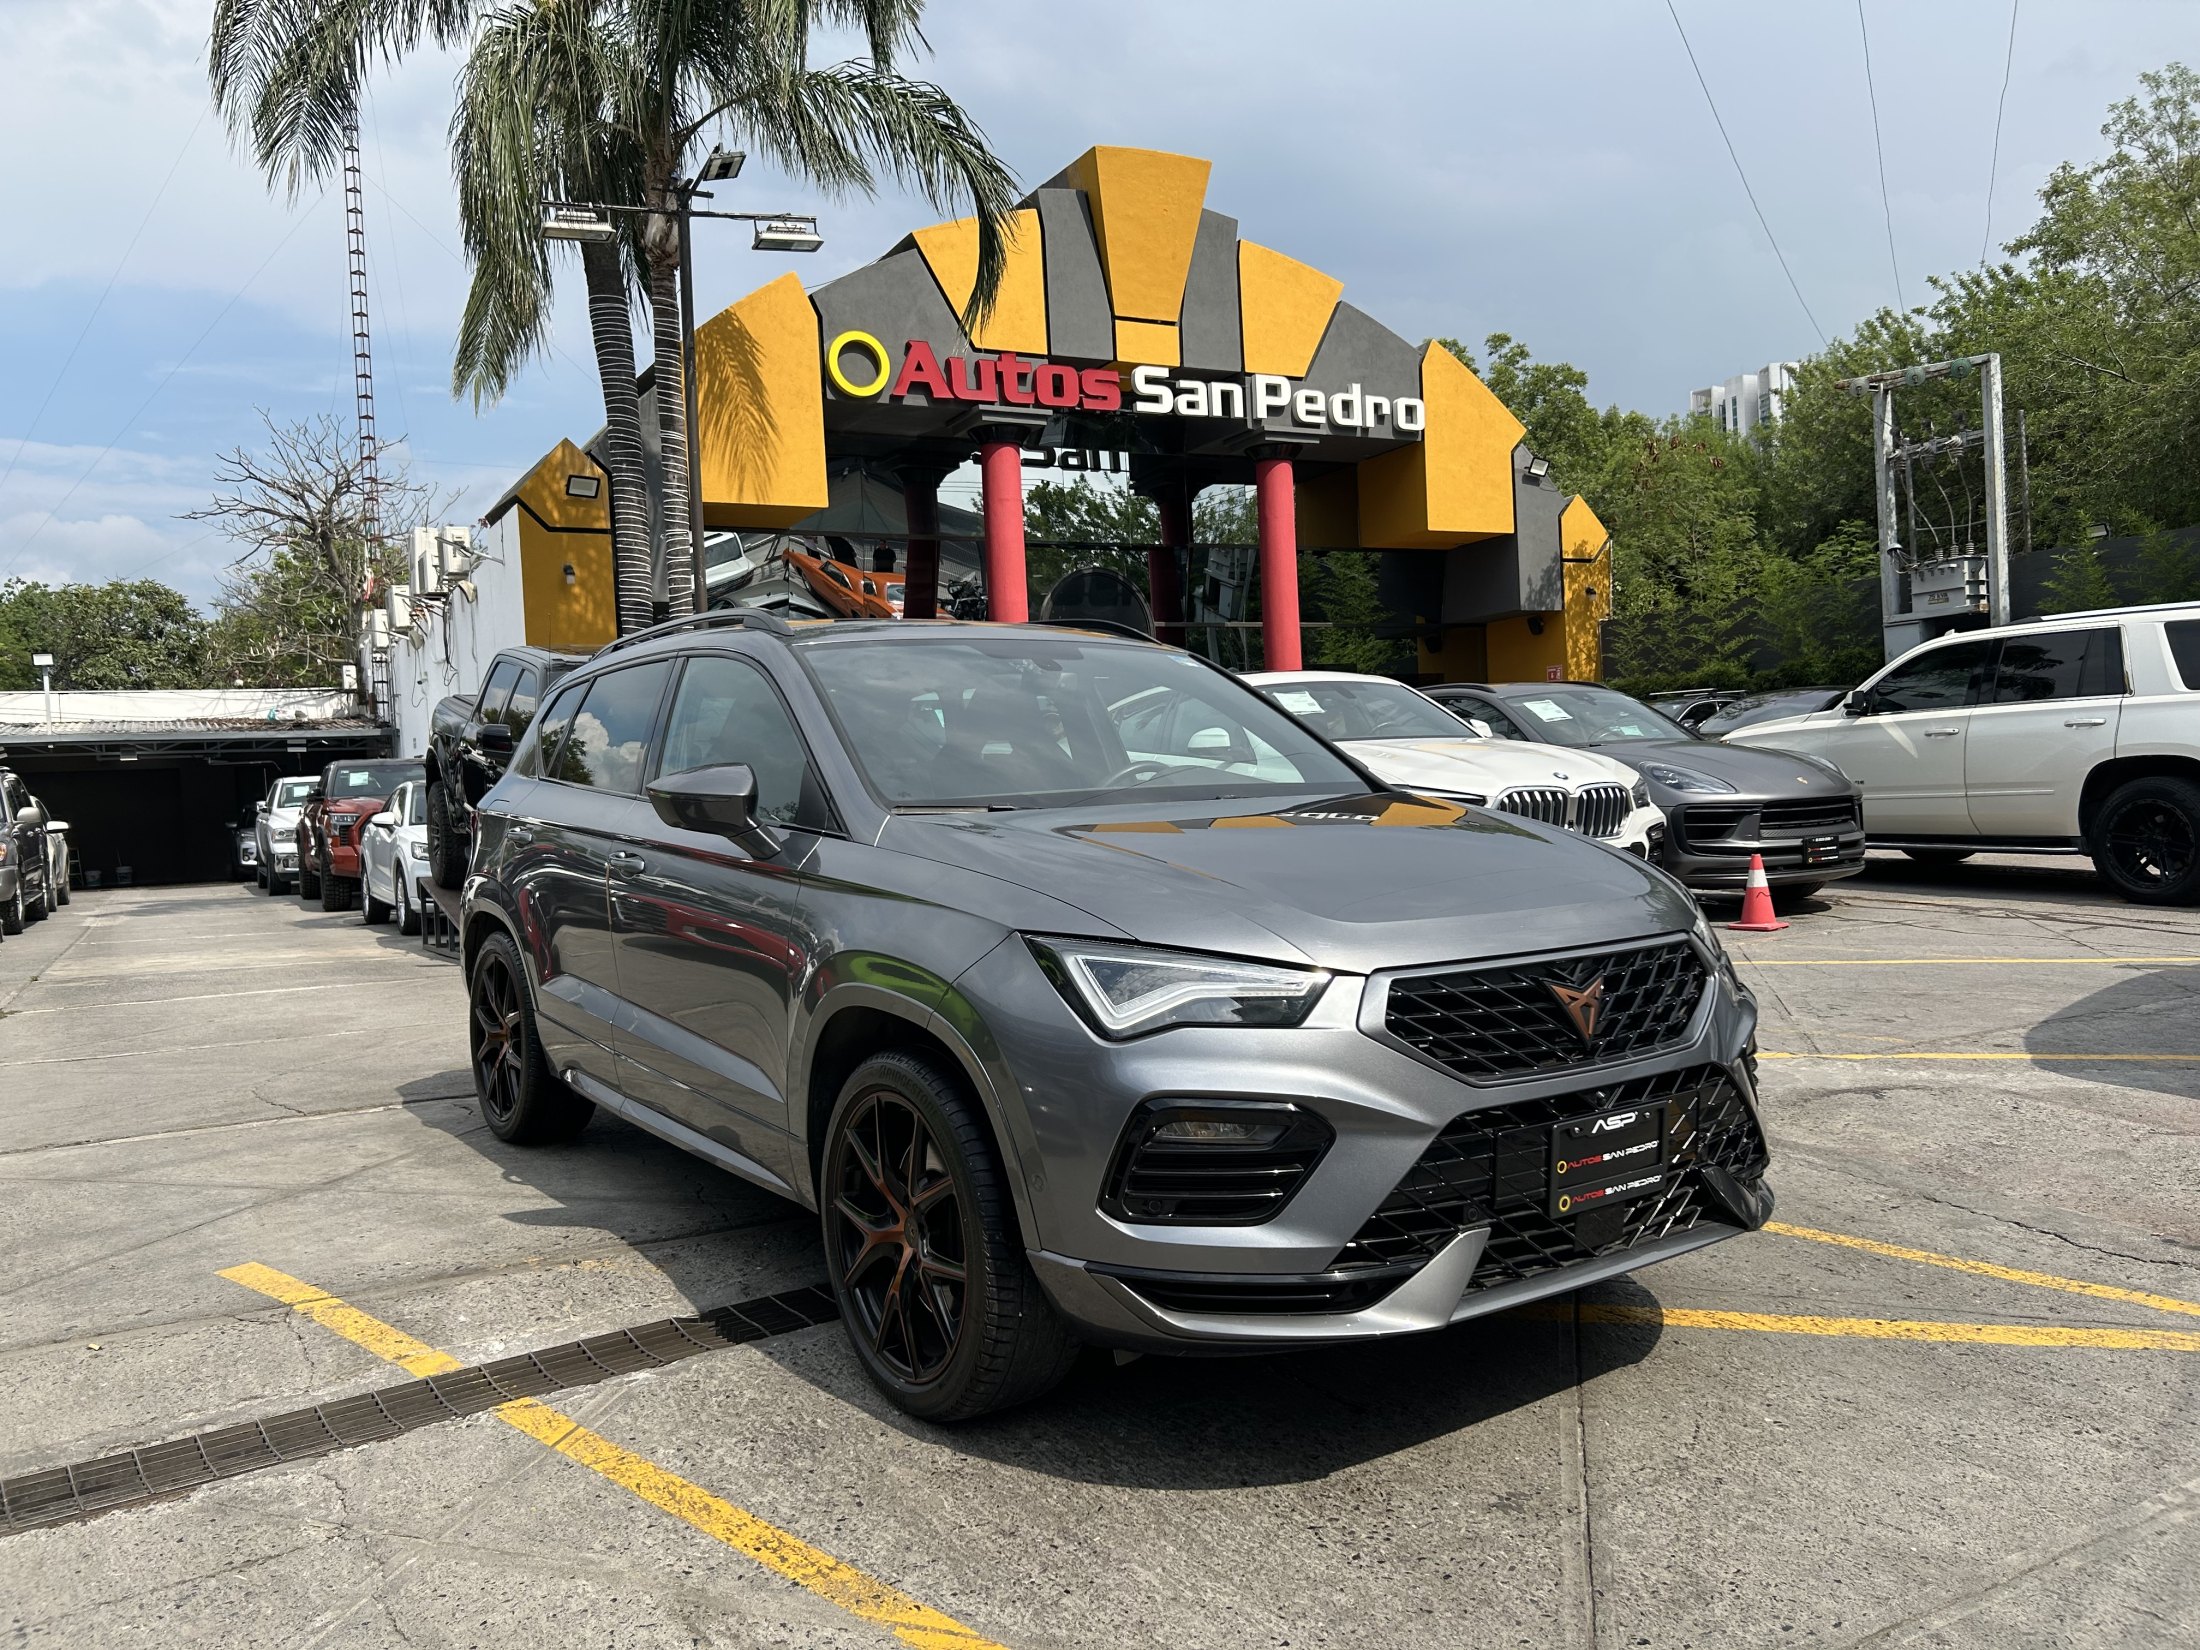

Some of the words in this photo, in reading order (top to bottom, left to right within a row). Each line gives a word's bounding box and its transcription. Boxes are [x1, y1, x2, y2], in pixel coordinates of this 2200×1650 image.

[891, 339, 1122, 411] Autos
[1591, 1112, 1636, 1134] ASP
[1567, 1155, 1602, 1169] AUTOS
[1602, 1149, 1625, 1161] SAN
[1625, 1140, 1659, 1155] PEDRO
[1572, 1189, 1604, 1203] AUTOS
[1604, 1182, 1626, 1195] SAN
[1627, 1175, 1662, 1189] PEDRO
